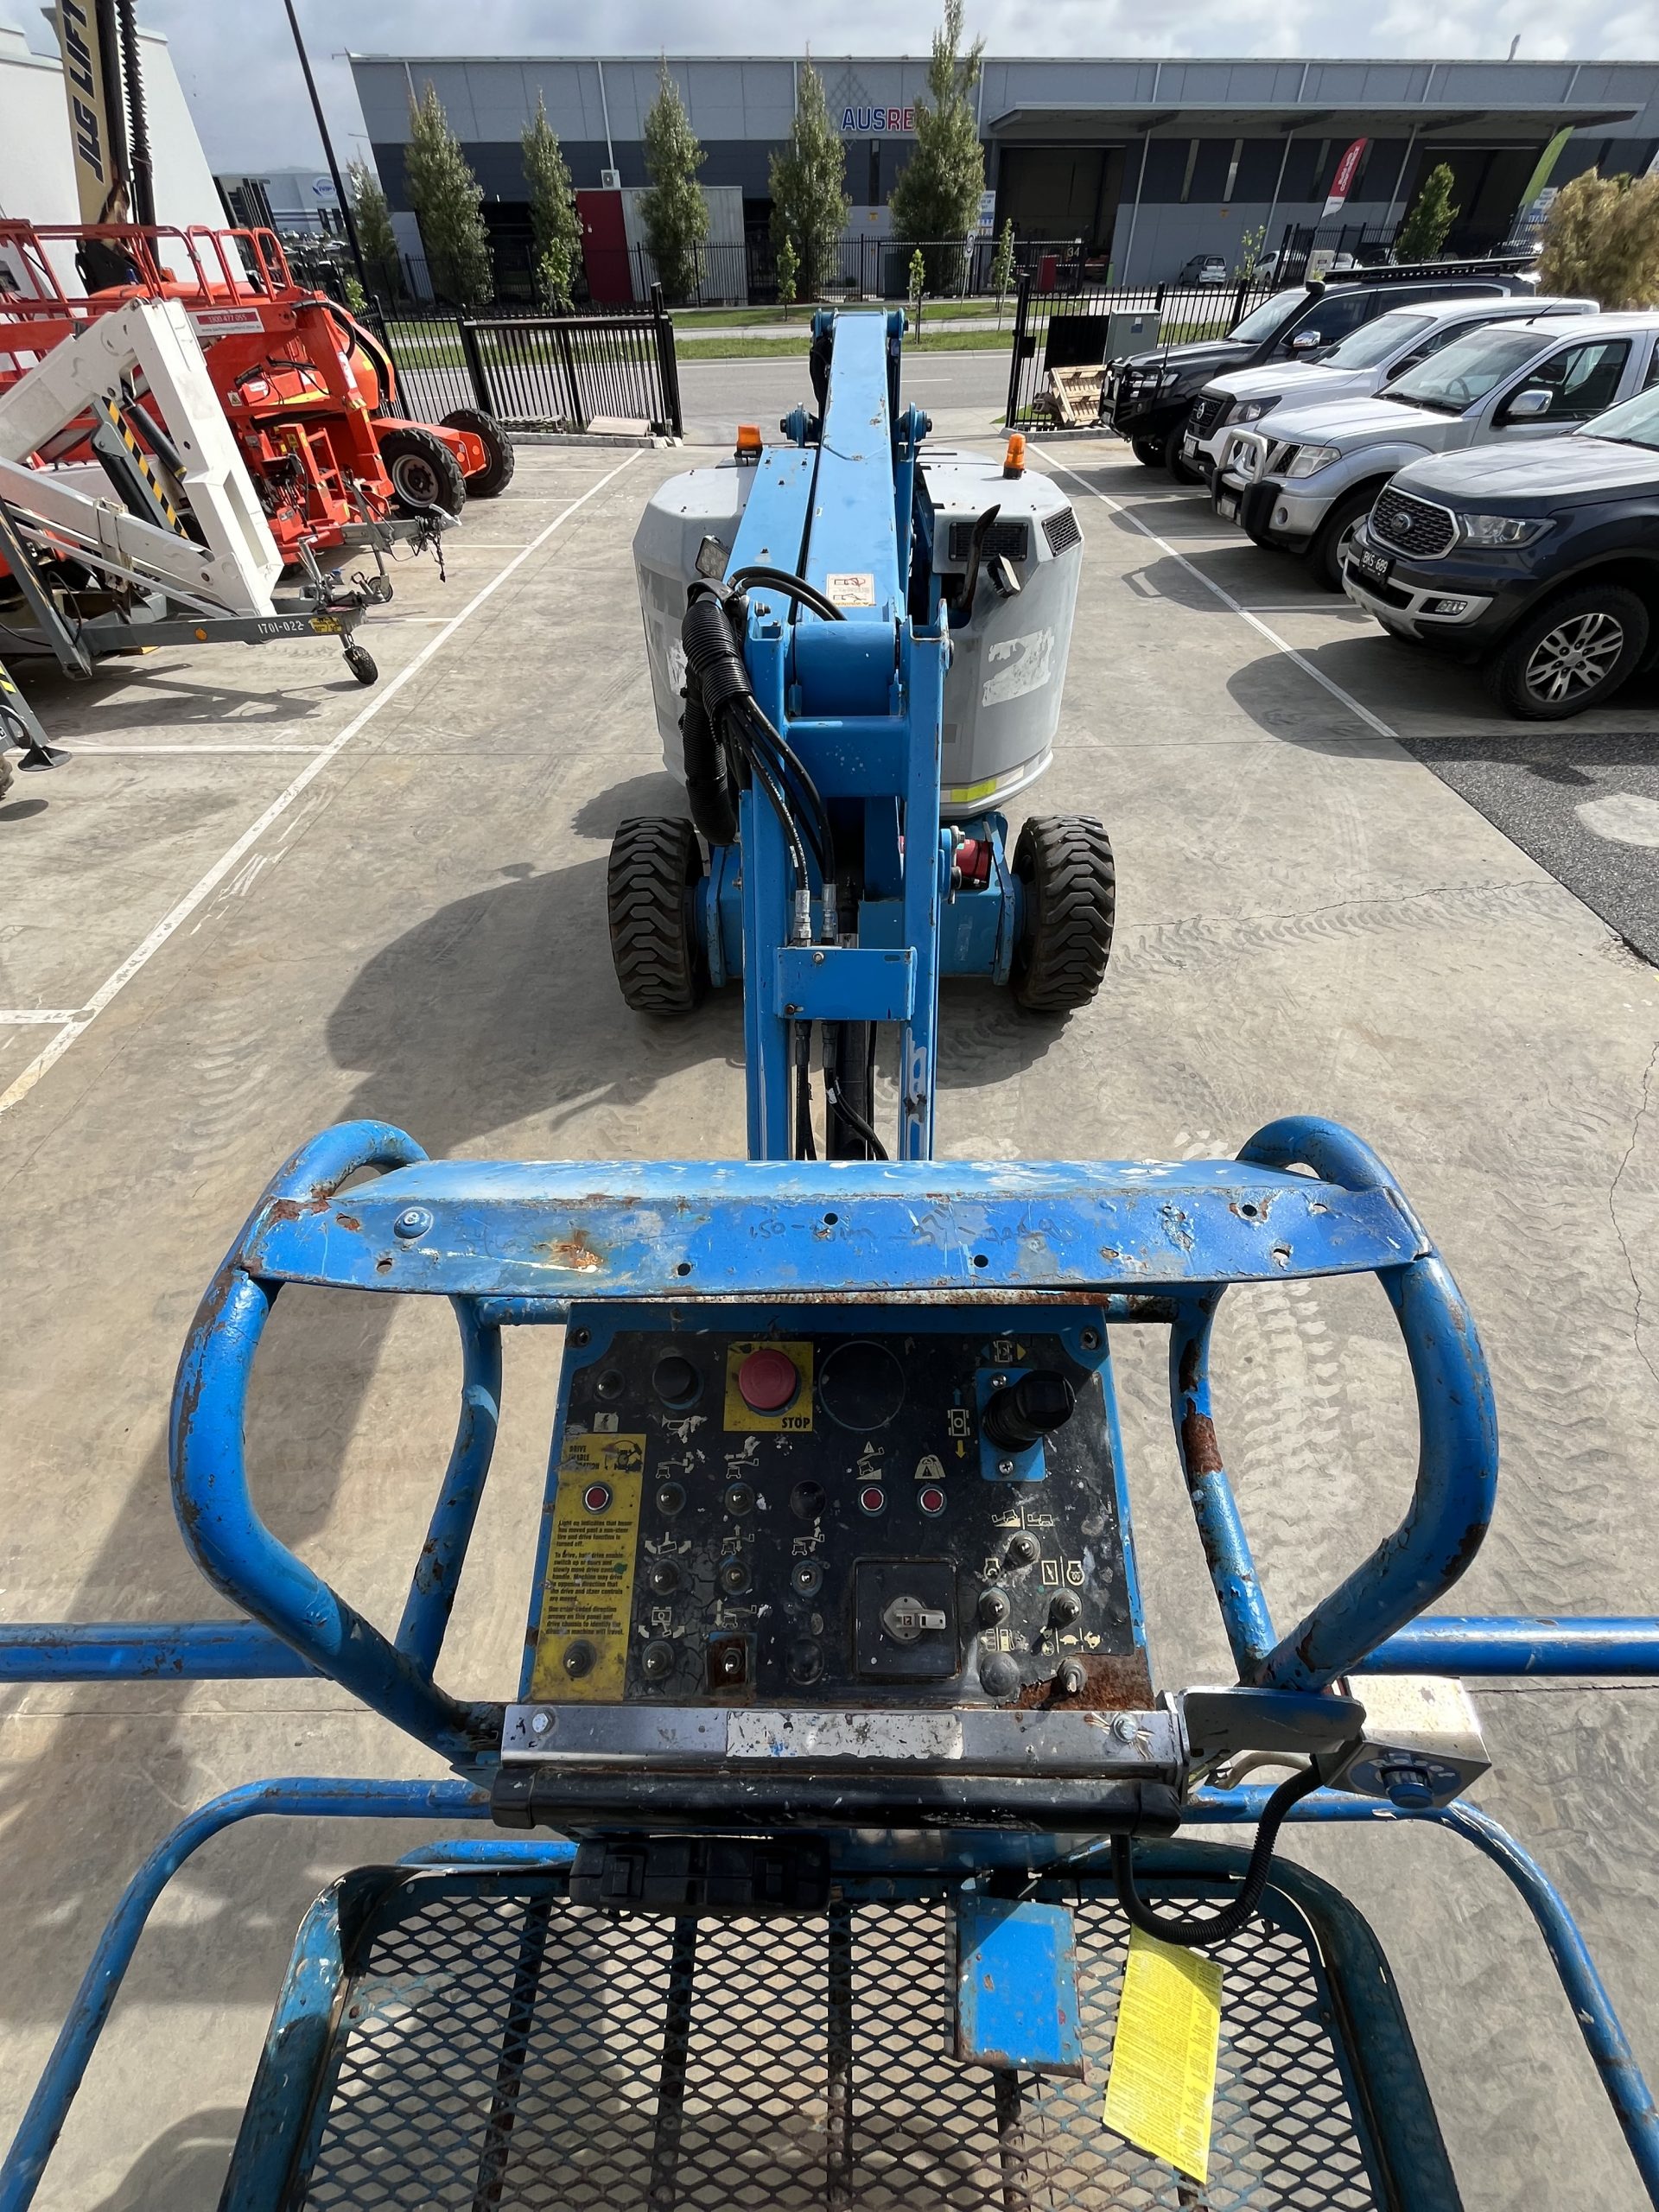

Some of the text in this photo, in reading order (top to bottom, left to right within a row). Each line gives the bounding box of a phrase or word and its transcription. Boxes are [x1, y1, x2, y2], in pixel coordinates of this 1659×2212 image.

[73, 96, 104, 184] JLG
[1376, 558, 1389, 573] 689
[782, 1416, 810, 1428] STOP
